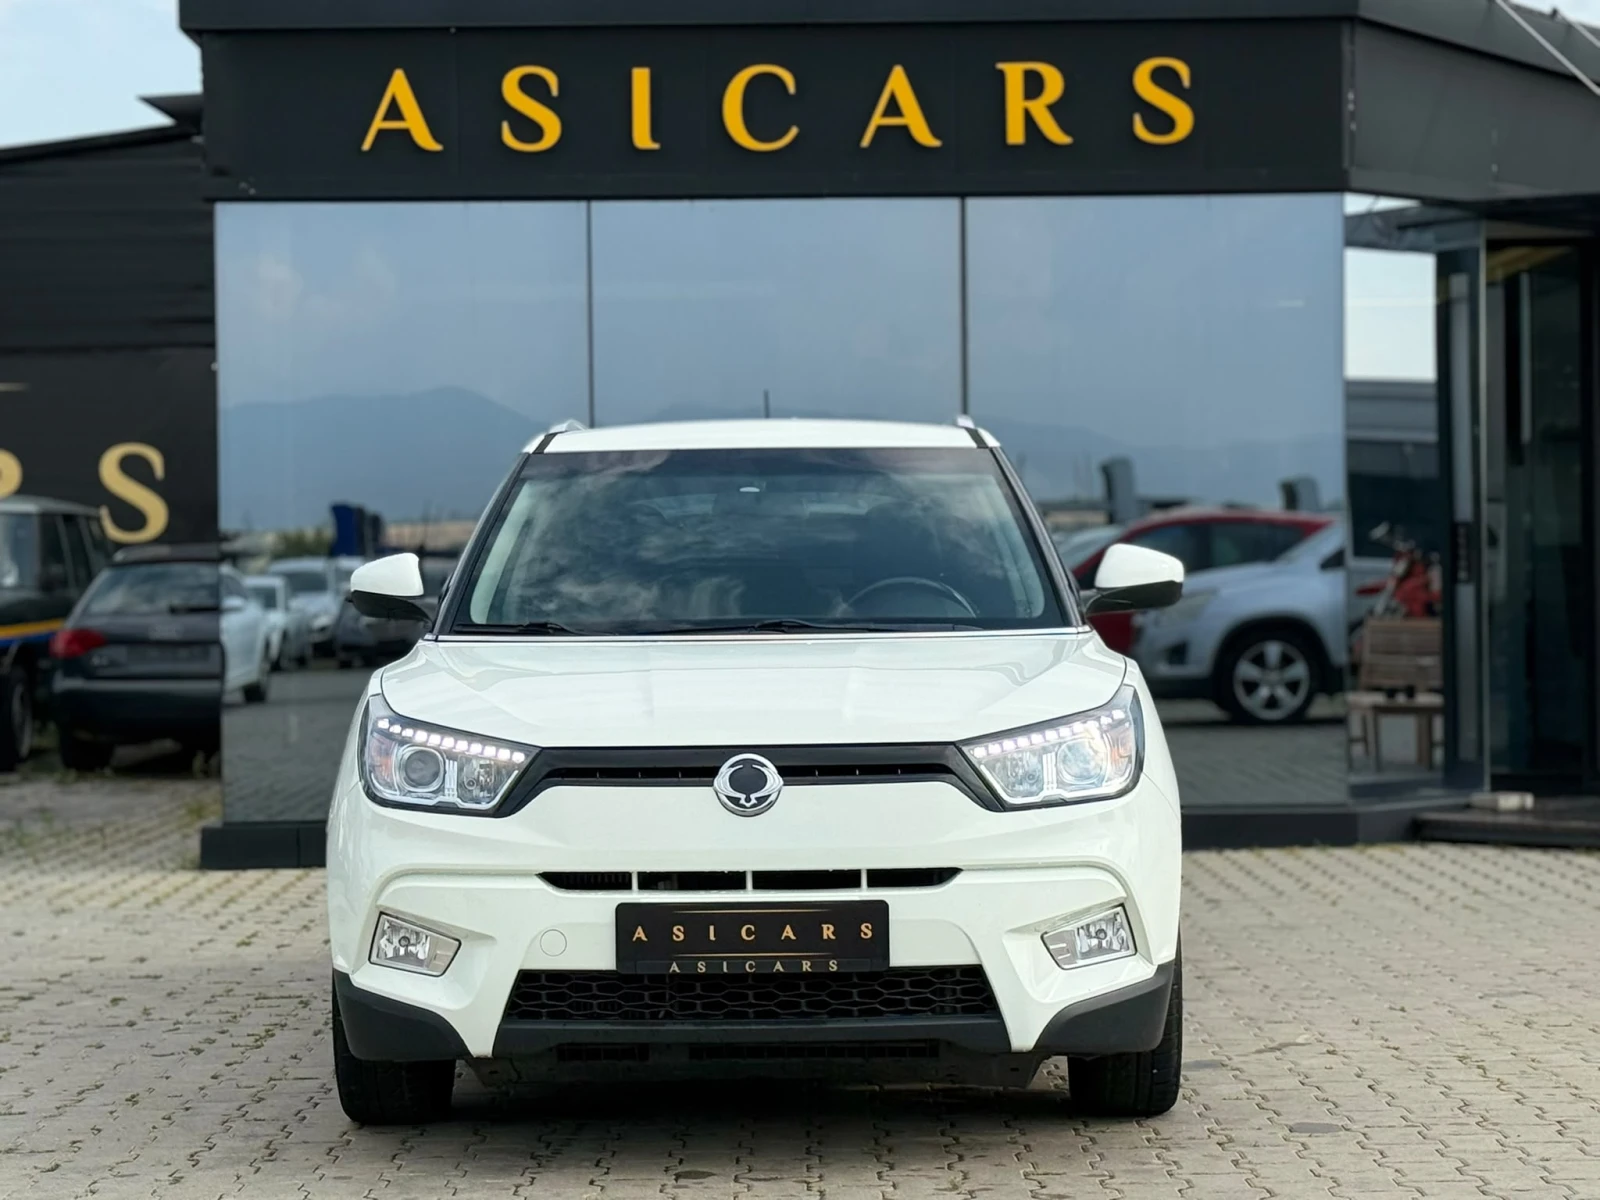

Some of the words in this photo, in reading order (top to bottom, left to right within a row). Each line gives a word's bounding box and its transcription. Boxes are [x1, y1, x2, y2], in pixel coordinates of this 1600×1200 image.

[361, 56, 1196, 153] ASICARS
[632, 923, 873, 941] ASICARS
[669, 960, 838, 973] ASICARS
